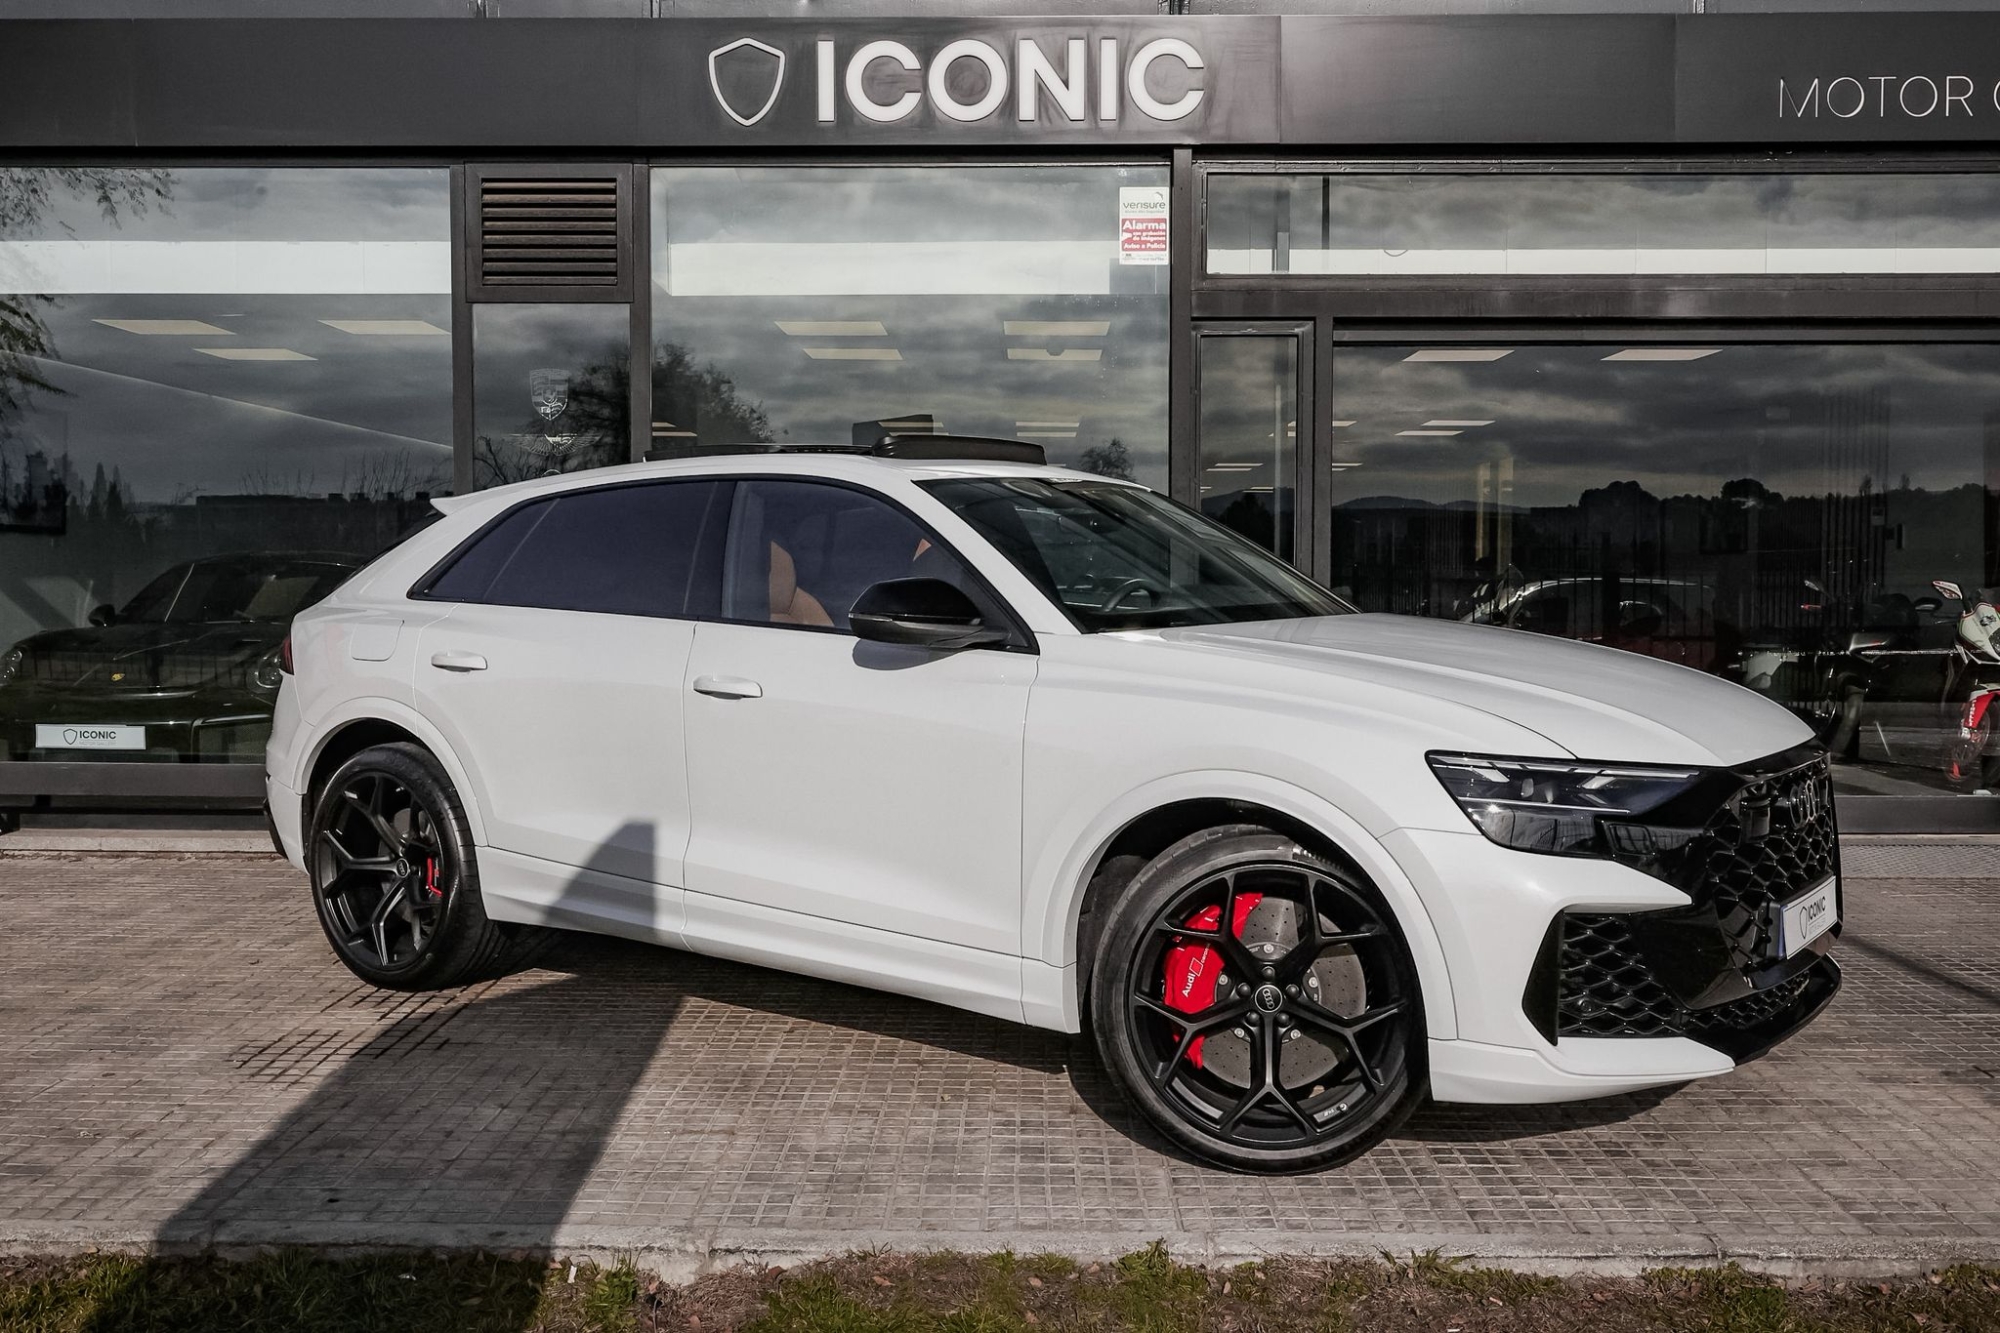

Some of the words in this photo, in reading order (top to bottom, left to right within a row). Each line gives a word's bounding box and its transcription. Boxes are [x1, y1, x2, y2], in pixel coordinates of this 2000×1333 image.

[817, 38, 1205, 122] ICONIC
[1779, 75, 1974, 118] MOTOR
[1122, 201, 1166, 209] verisure
[1122, 220, 1166, 230] Alarma
[79, 730, 117, 740] ICONIC
[1807, 895, 1826, 922] ICONIC
[1182, 972, 1196, 998] Audi
